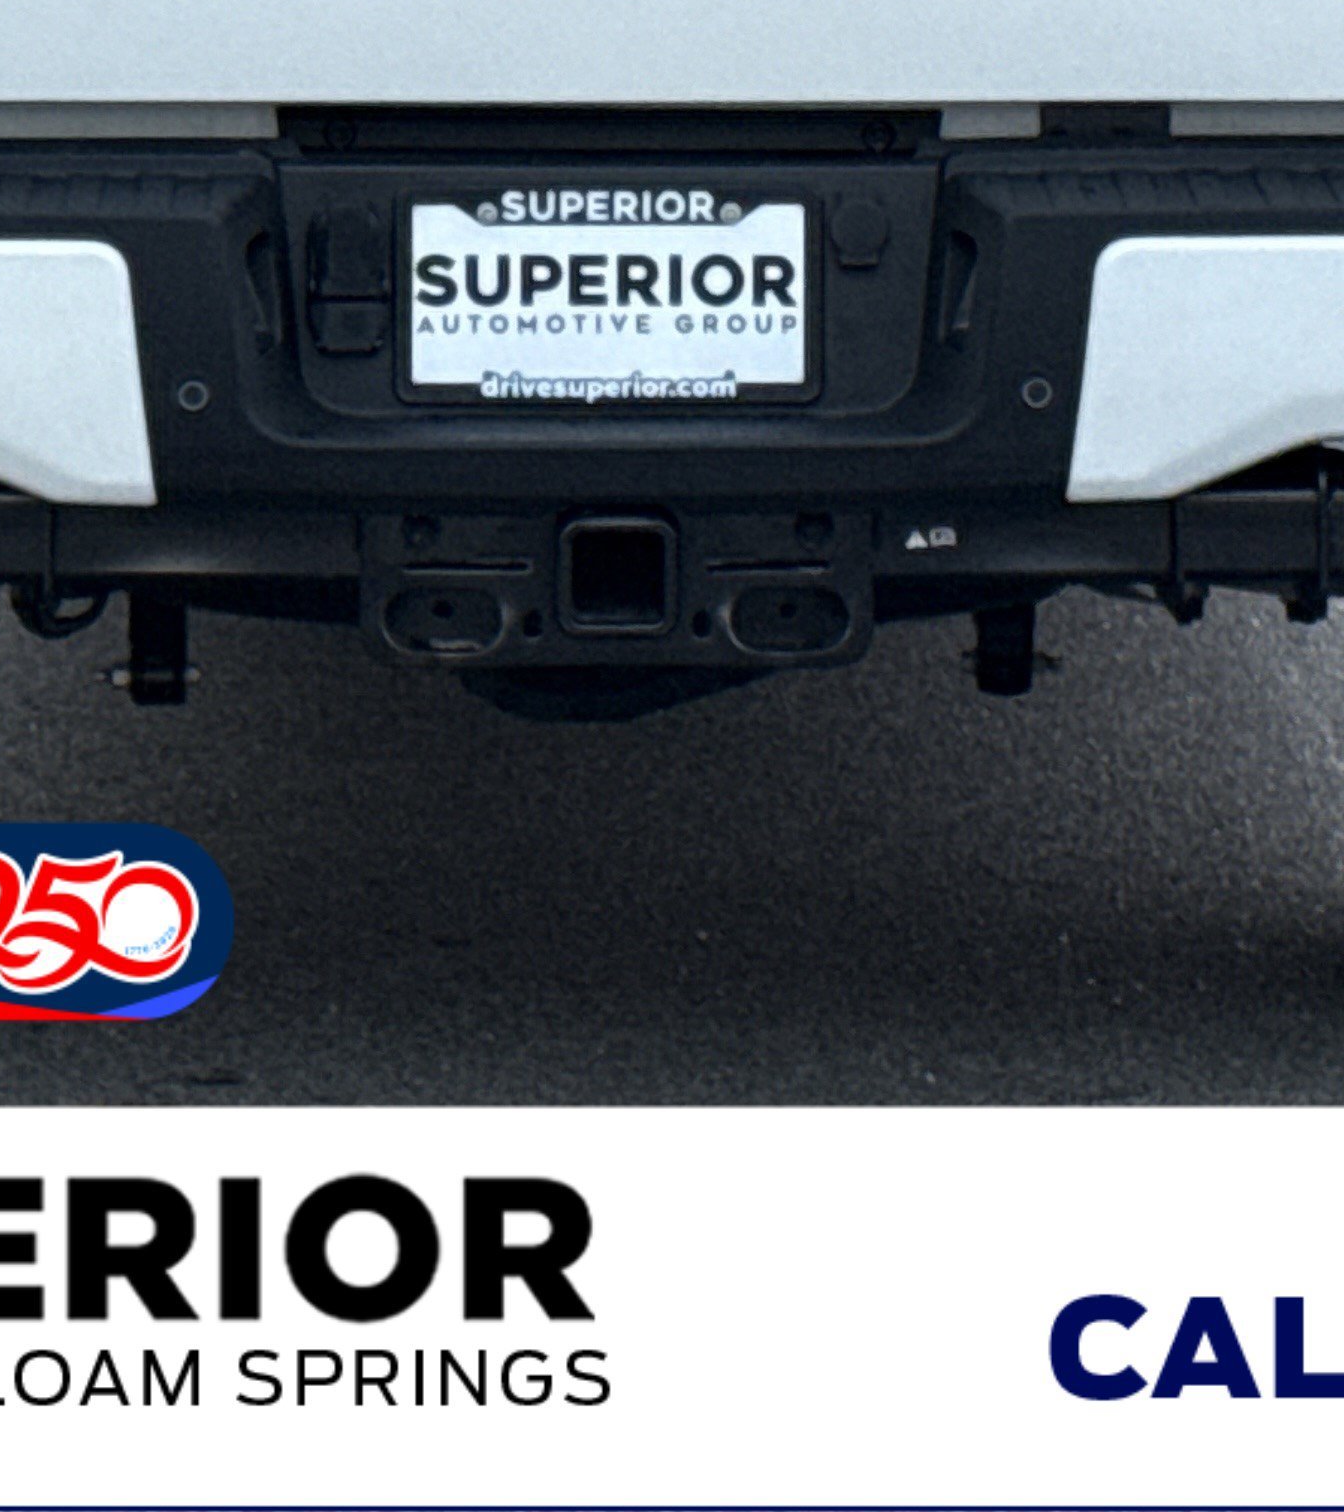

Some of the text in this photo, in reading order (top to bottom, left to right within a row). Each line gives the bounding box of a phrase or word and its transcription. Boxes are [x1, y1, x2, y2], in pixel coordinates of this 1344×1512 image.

[500, 189, 716, 223] SUPERIOR
[416, 254, 797, 307] SUPERIOR
[417, 313, 798, 335] AUTOMOTIVE GROUP
[480, 370, 738, 404] drivesuperior.com
